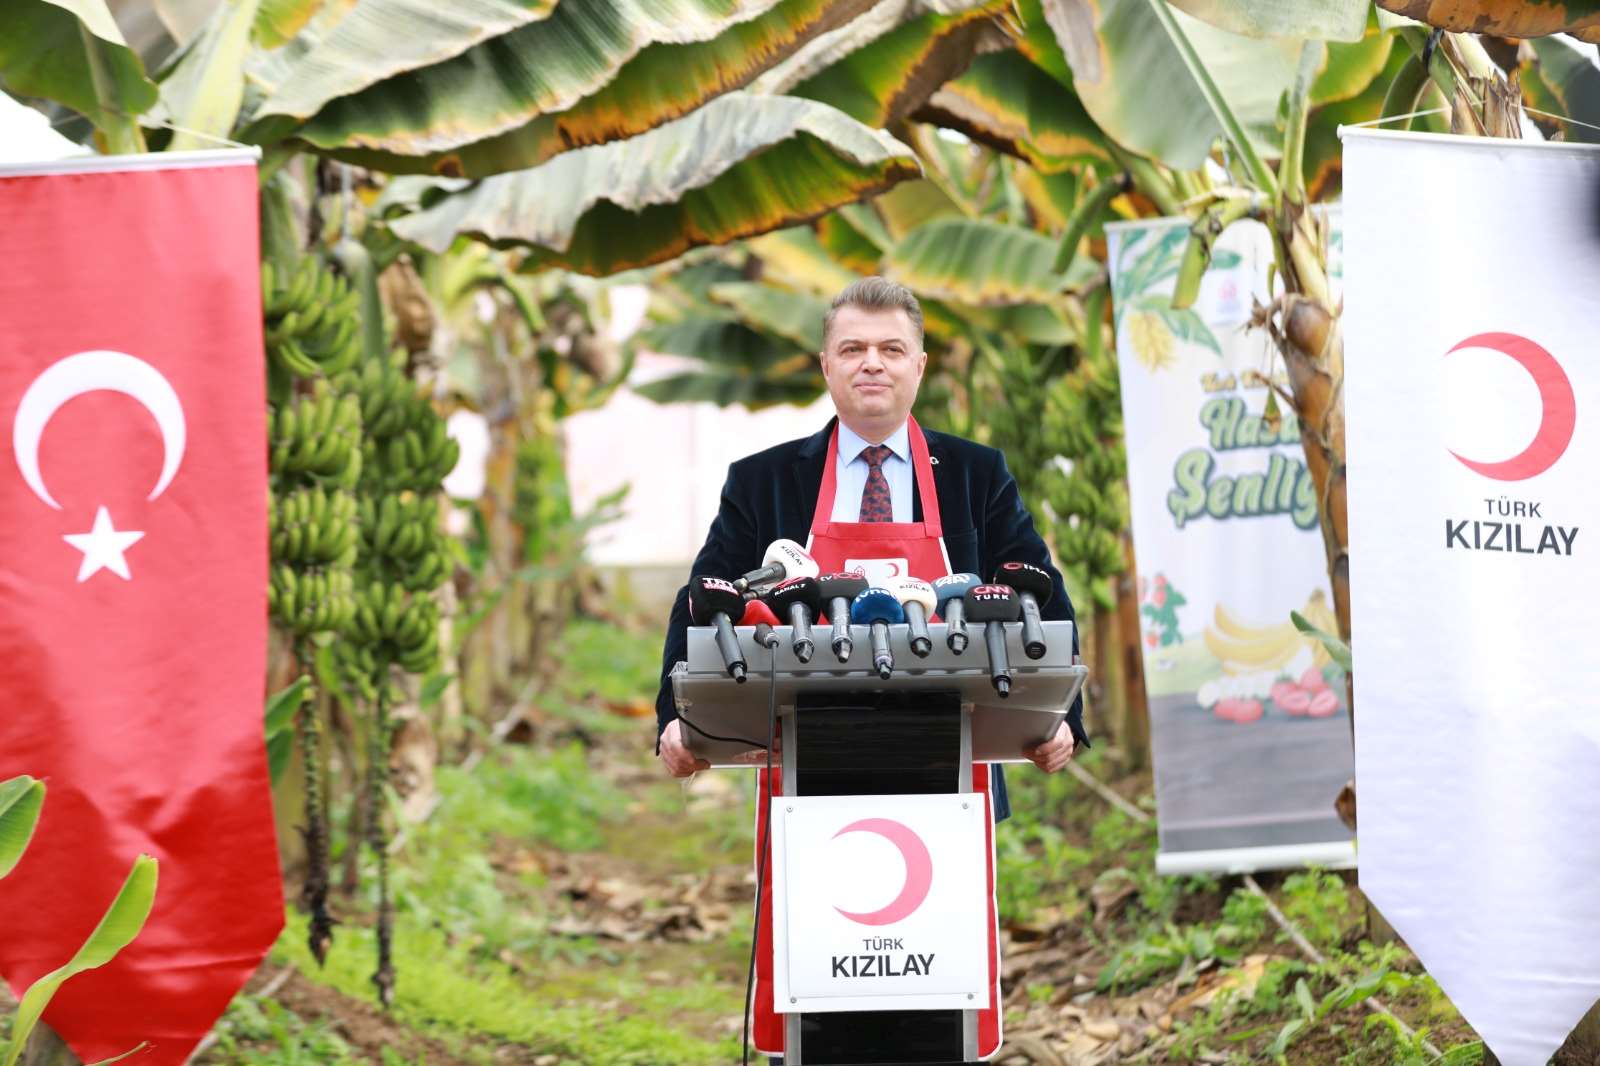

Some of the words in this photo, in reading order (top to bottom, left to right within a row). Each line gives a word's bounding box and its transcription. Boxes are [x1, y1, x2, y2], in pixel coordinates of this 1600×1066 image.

[1484, 495, 1541, 518] TÜRK
[1446, 519, 1579, 556] KIZILAY
[774, 584, 799, 596] KANAL
[974, 586, 1010, 594] CNN
[862, 936, 904, 951] TÜRK
[831, 954, 935, 978] KIZILAY
